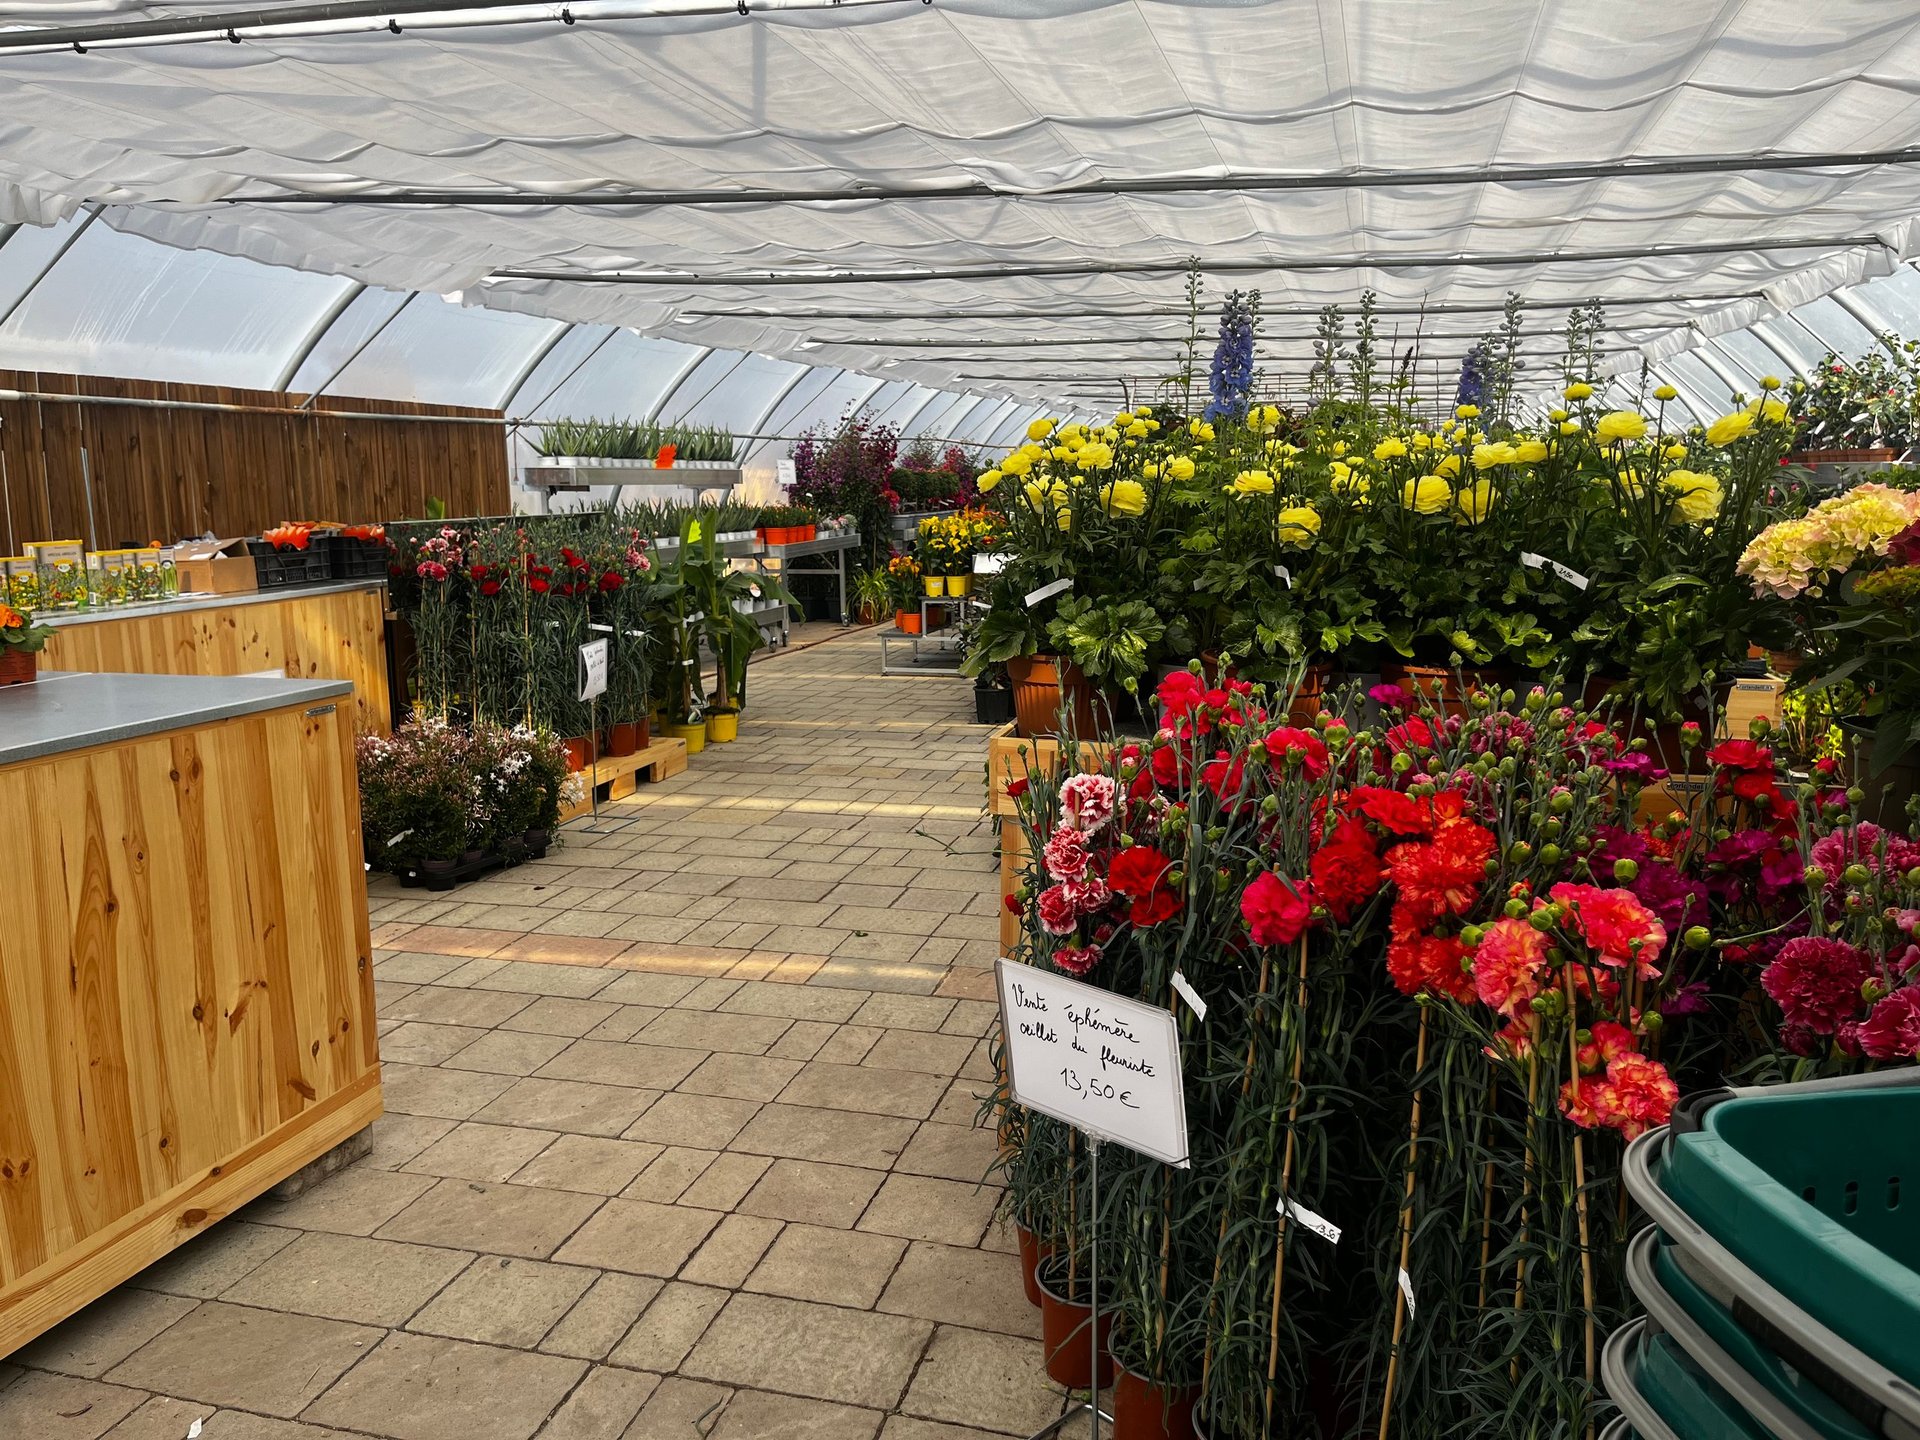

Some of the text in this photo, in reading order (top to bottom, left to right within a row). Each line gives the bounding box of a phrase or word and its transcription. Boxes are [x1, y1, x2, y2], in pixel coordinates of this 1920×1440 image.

[1011, 983, 1140, 1044] Vente éphémère
[1071, 1036, 1088, 1054] du
[1099, 1045, 1156, 1078] fleuriste
